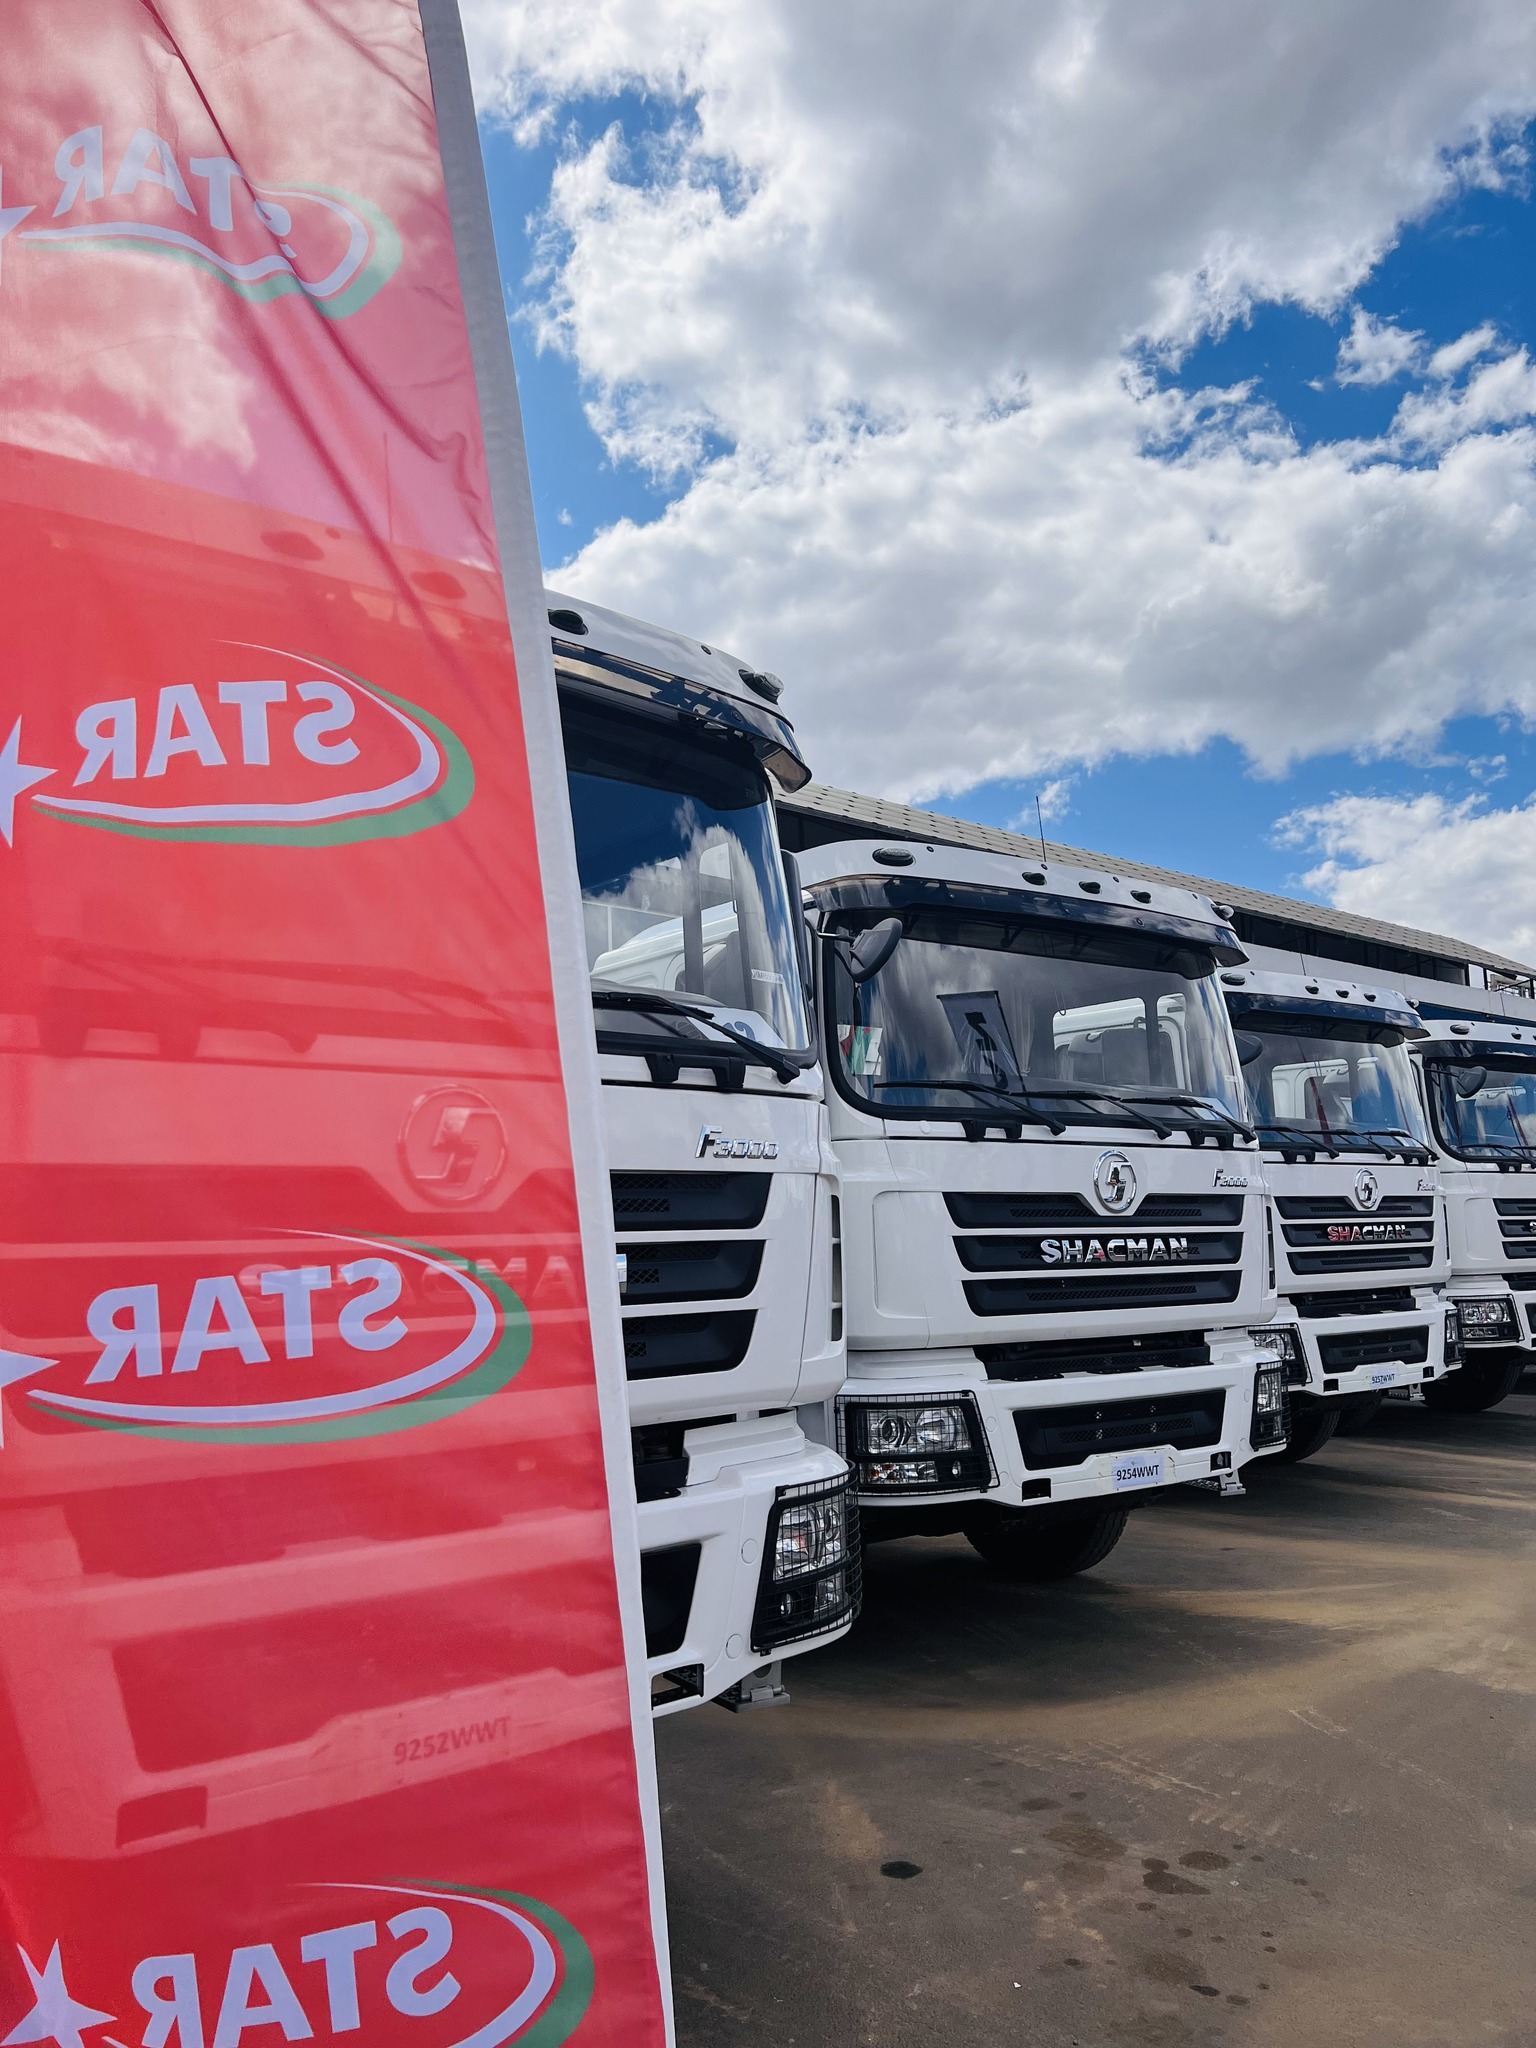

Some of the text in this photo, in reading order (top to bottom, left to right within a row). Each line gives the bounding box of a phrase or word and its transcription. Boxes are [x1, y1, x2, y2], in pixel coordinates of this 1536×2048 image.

[695, 1124, 779, 1160] F3000
[1326, 1224, 1406, 1242] SHACMAN
[1040, 1237, 1188, 1264] SHACMAN
[1116, 1464, 1160, 1481] 9254WWT
[393, 1715, 511, 1765] 9252WWT
